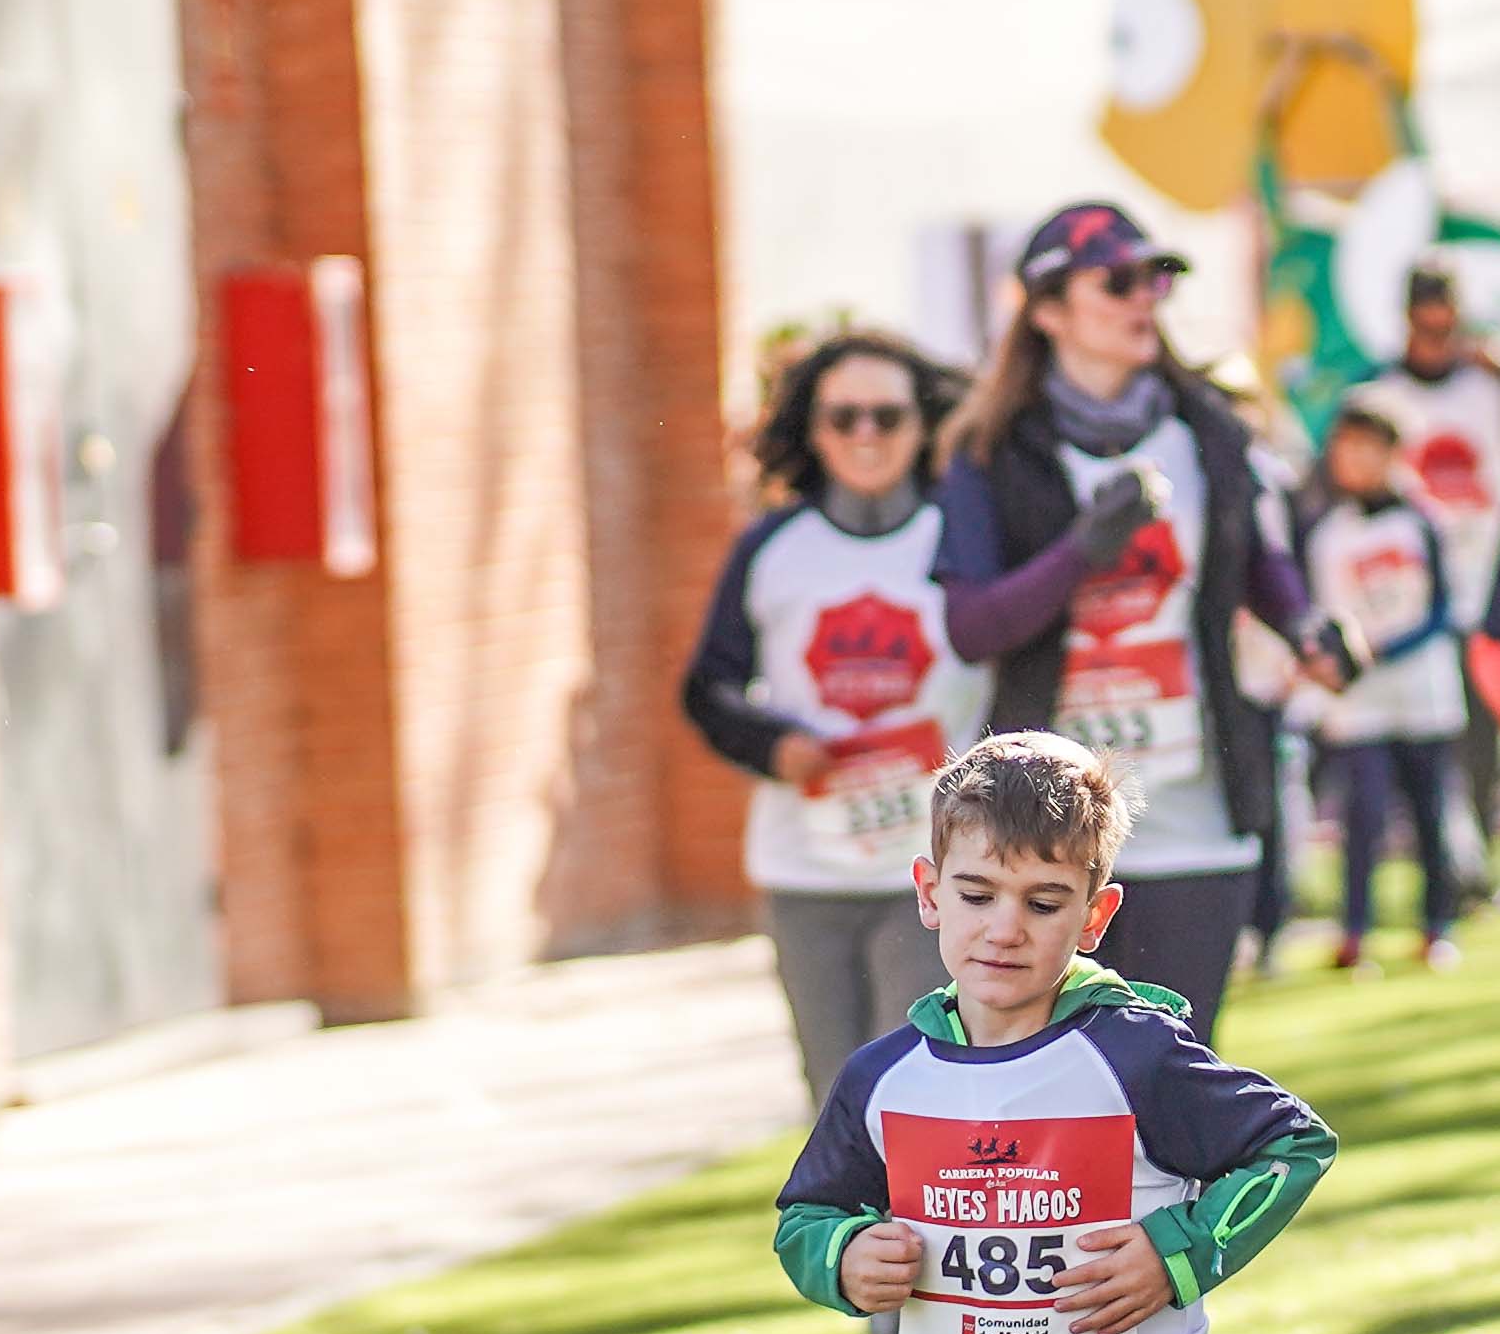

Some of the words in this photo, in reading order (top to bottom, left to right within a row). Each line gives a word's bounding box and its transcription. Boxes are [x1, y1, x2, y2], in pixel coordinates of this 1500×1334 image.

[938, 1168, 994, 1179] CARRERA
[997, 1168, 1060, 1181] POPULAR
[922, 1184, 987, 1222] REYES
[997, 1187, 1082, 1223] MAGOS
[941, 1234, 1067, 1296] 485
[978, 1317, 1049, 1328] Comunidad
